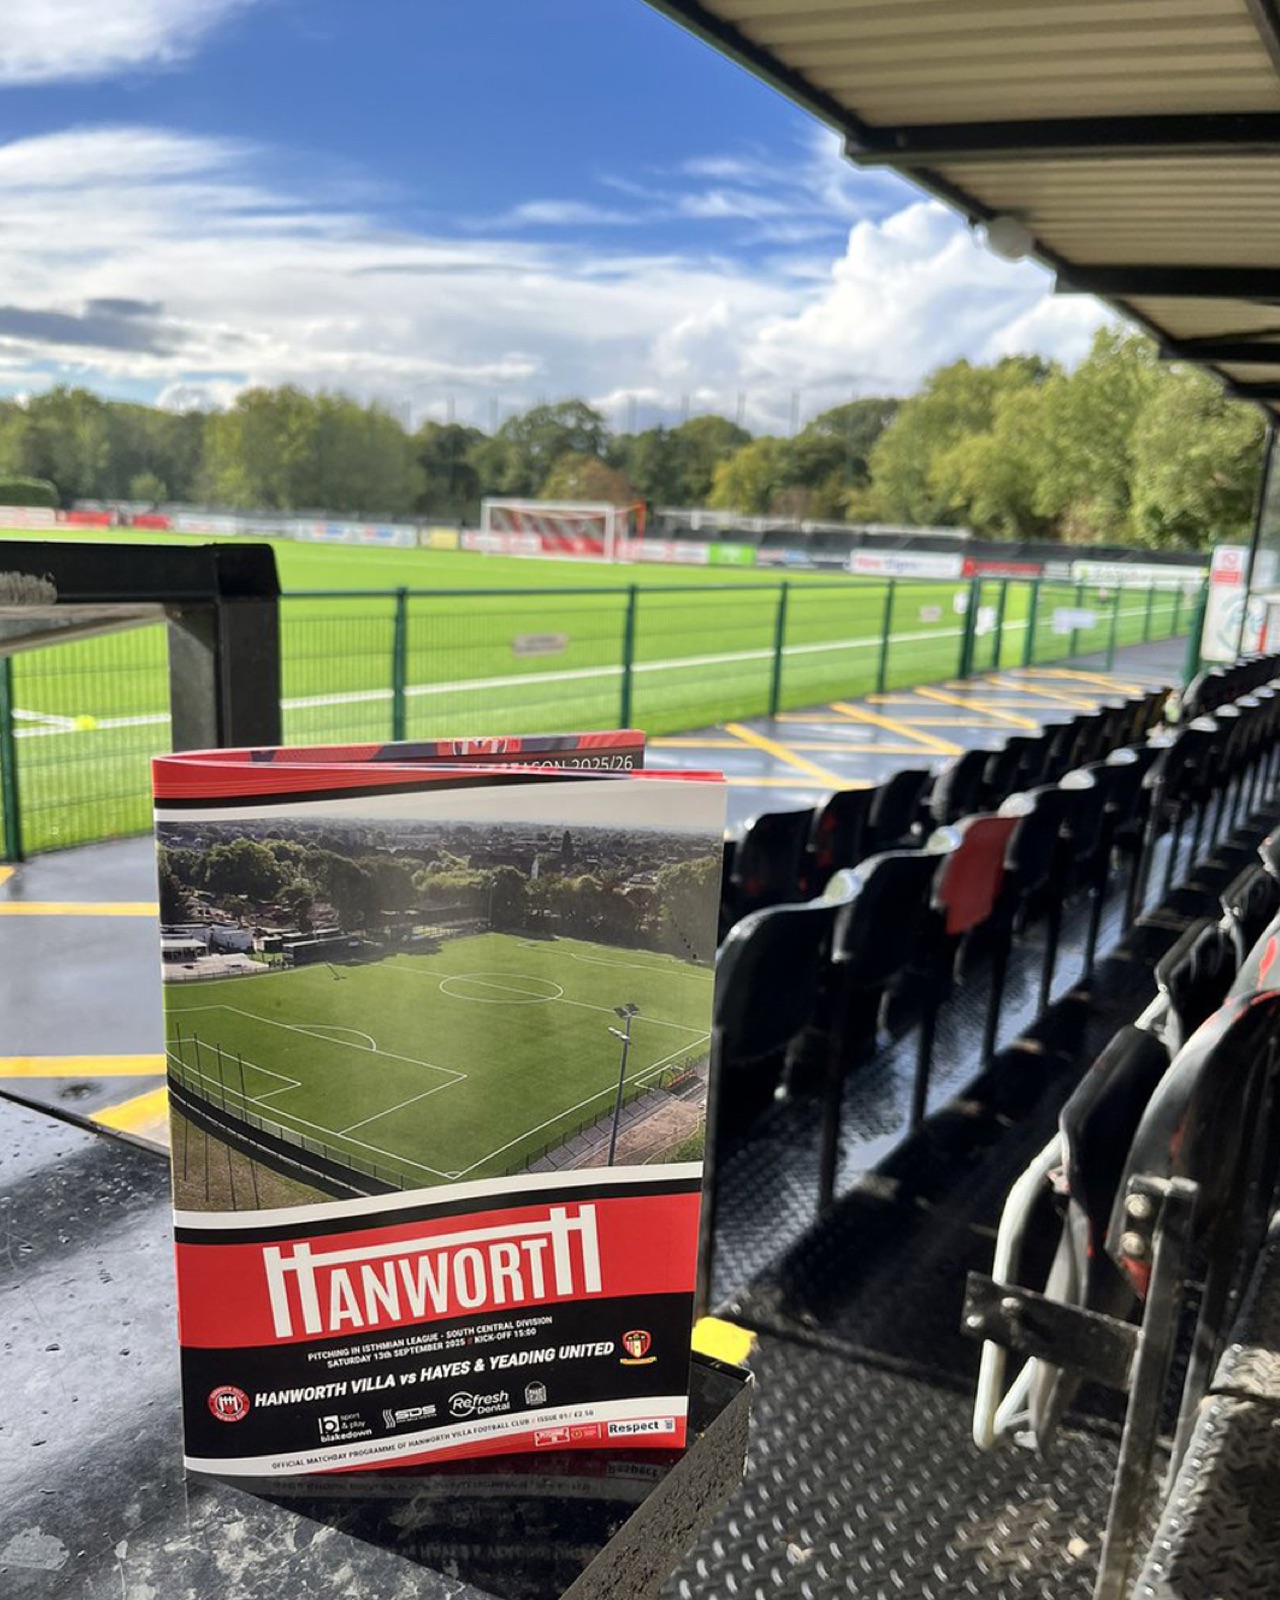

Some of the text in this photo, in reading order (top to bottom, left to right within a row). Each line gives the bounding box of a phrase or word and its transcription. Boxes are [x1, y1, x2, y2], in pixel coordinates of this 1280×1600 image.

[571, 755, 633, 770] 2025/26
[262, 1203, 602, 1338] HANWORTH
[308, 1348, 350, 1361] PITCHING
[351, 1346, 360, 1355] IN
[362, 1339, 405, 1352] ISTHMIAN
[406, 1332, 439, 1346] LEAGUE
[446, 1327, 475, 1339] SOUTH
[476, 1321, 514, 1334] CENTRAL
[516, 1316, 553, 1327] DIVISION
[327, 1354, 372, 1369] SATURDAY
[374, 1350, 392, 1360] 13th
[393, 1341, 443, 1358] SEPTEMBER
[445, 1338, 466, 1348] 2025
[474, 1331, 512, 1344] KICK-OFF
[514, 1328, 537, 1338] 15:00
[254, 1381, 347, 1407] HANWORTH
[351, 1373, 396, 1395] VILLA
[400, 1373, 417, 1386] vs
[420, 1358, 471, 1382] HAYES
[473, 1358, 486, 1372] &
[489, 1346, 556, 1371] YEADING
[558, 1341, 615, 1360] UNITED
[452, 1389, 509, 1410] Refresh
[477, 1401, 511, 1415] Dental
[271, 1460, 304, 1470] OFFICIAL
[306, 1452, 347, 1465] MATCHDAY
[348, 1445, 395, 1459] PROGRAMME
[408, 1433, 451, 1447] HANWORTH
[451, 1429, 472, 1439] VILLA
[473, 1422, 509, 1434] FOOTBALL
[511, 1419, 530, 1428] CLUB
[537, 1414, 557, 1422] ISSUE
[320, 1429, 373, 1442] blakedown
[609, 1420, 659, 1434] Respect
